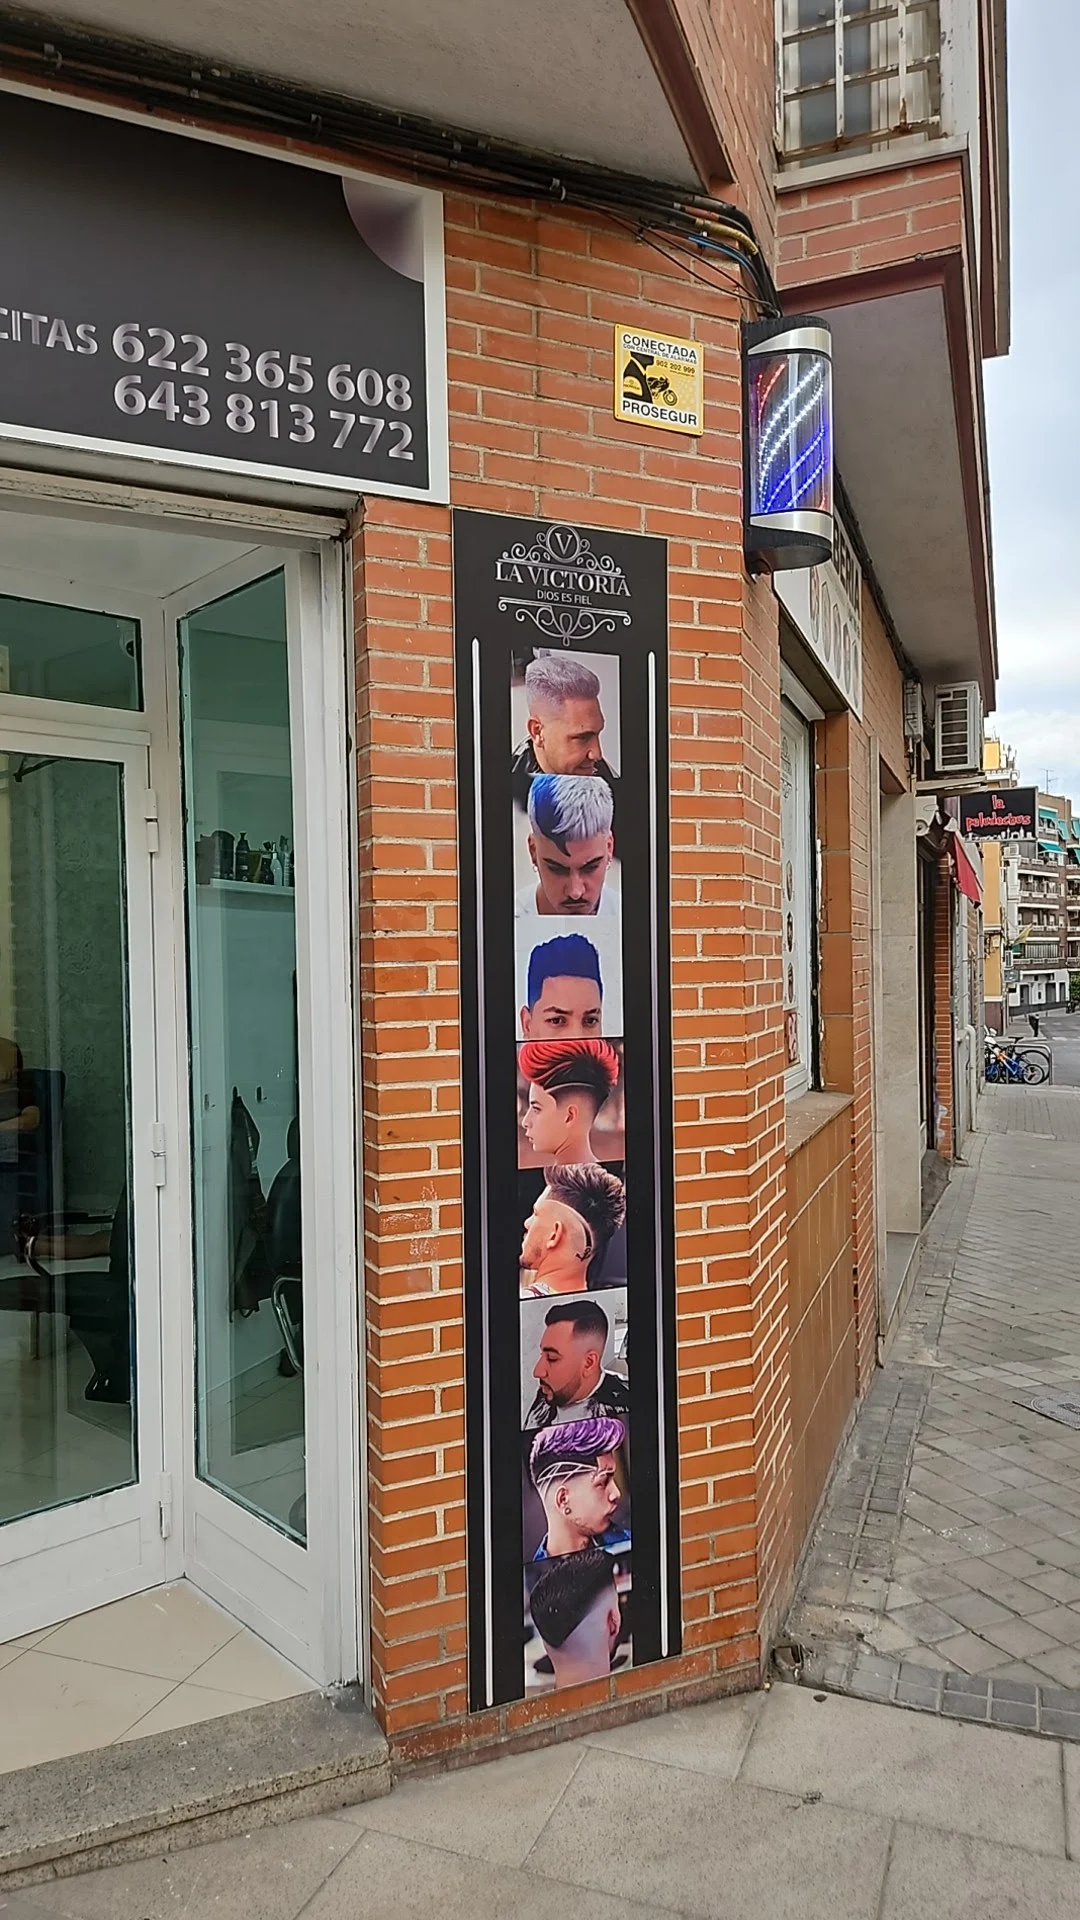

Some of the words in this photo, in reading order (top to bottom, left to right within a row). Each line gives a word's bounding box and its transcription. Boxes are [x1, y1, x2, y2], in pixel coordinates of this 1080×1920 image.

[622, 333, 697, 360] CONECTADA
[636, 346, 661, 357] CENTRAL
[670, 354, 697, 365] ALARMAS
[112, 323, 210, 377] 622
[224, 342, 315, 394] 365
[327, 363, 413, 412] 608
[670, 363, 681, 371] 202
[113, 374, 212, 427] 643
[225, 393, 317, 444] 813
[329, 409, 415, 461] 772
[622, 400, 697, 426] PROSEGUR
[554, 532, 573, 556] V
[495, 561, 524, 584] LA
[527, 566, 632, 597] VICTORIA
[537, 589, 560, 601] DIOS
[561, 592, 573, 604] ES
[574, 594, 593, 606] FIEL
